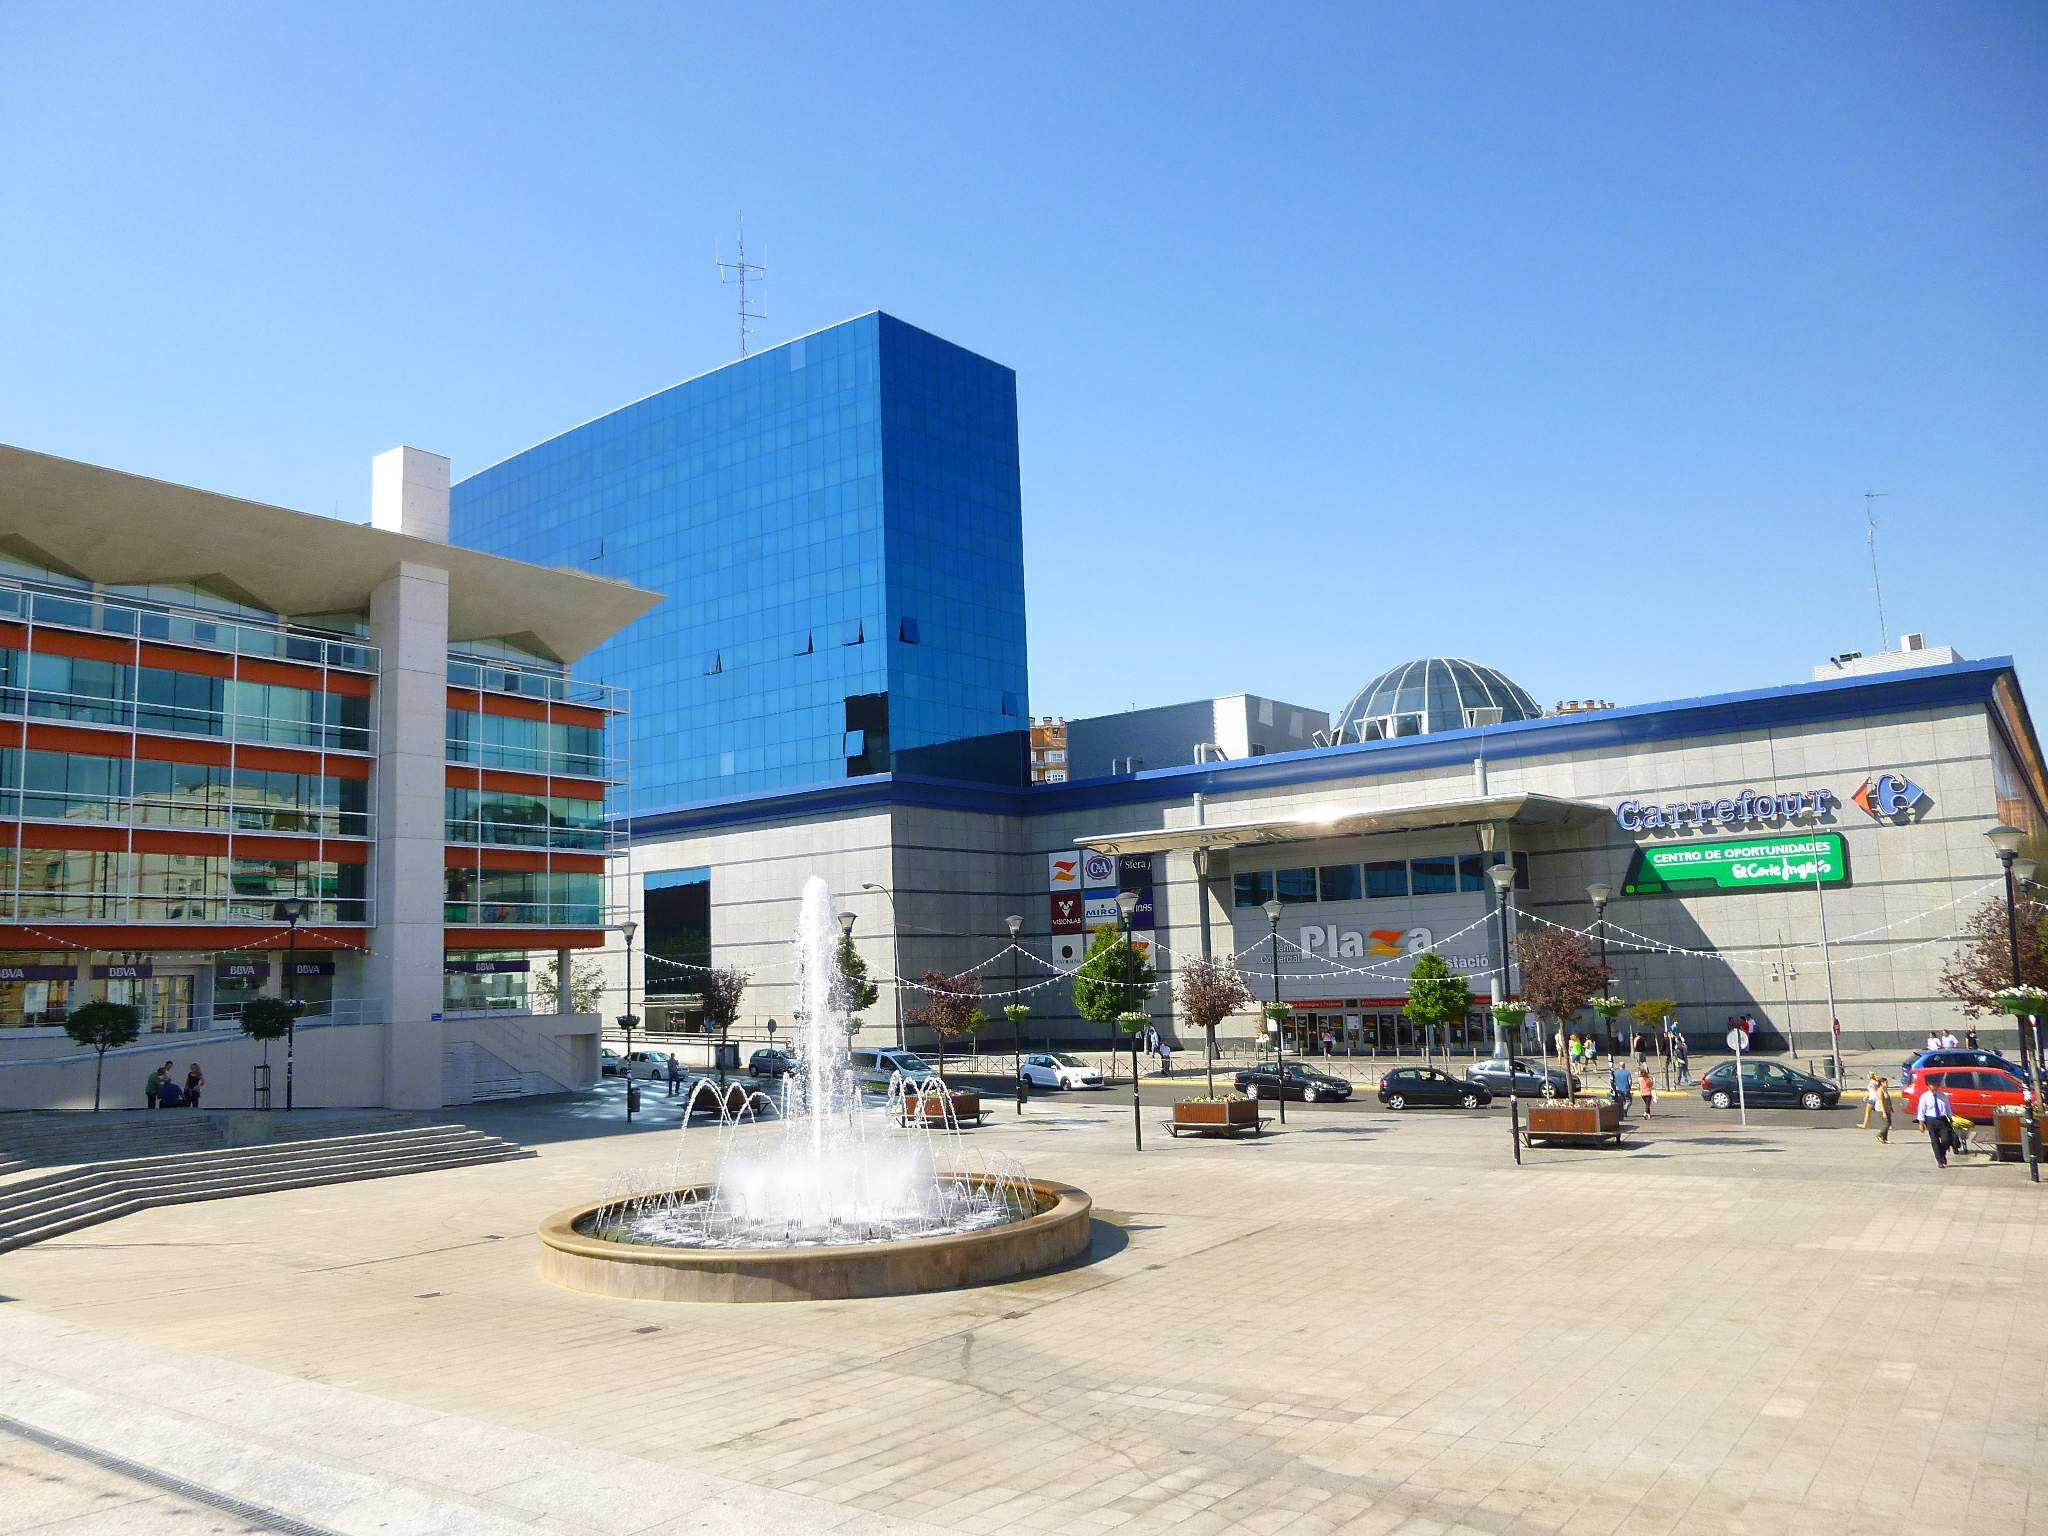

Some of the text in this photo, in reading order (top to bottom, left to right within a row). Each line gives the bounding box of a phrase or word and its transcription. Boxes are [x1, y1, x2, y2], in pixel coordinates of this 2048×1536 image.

[1617, 788, 1834, 831] Carrefour
[1653, 841, 1831, 864] CENTRO DE OPORTUNIDADES
[1731, 864, 1748, 878] El
[1747, 863, 1782, 878] Corte
[1260, 952, 1301, 964] Coercial
[1441, 953, 1489, 968] stació
[0, 968, 25, 979] BVA
[109, 967, 137, 977] BBVA
[230, 965, 255, 975] BBVA
[296, 964, 320, 974] BBVA
